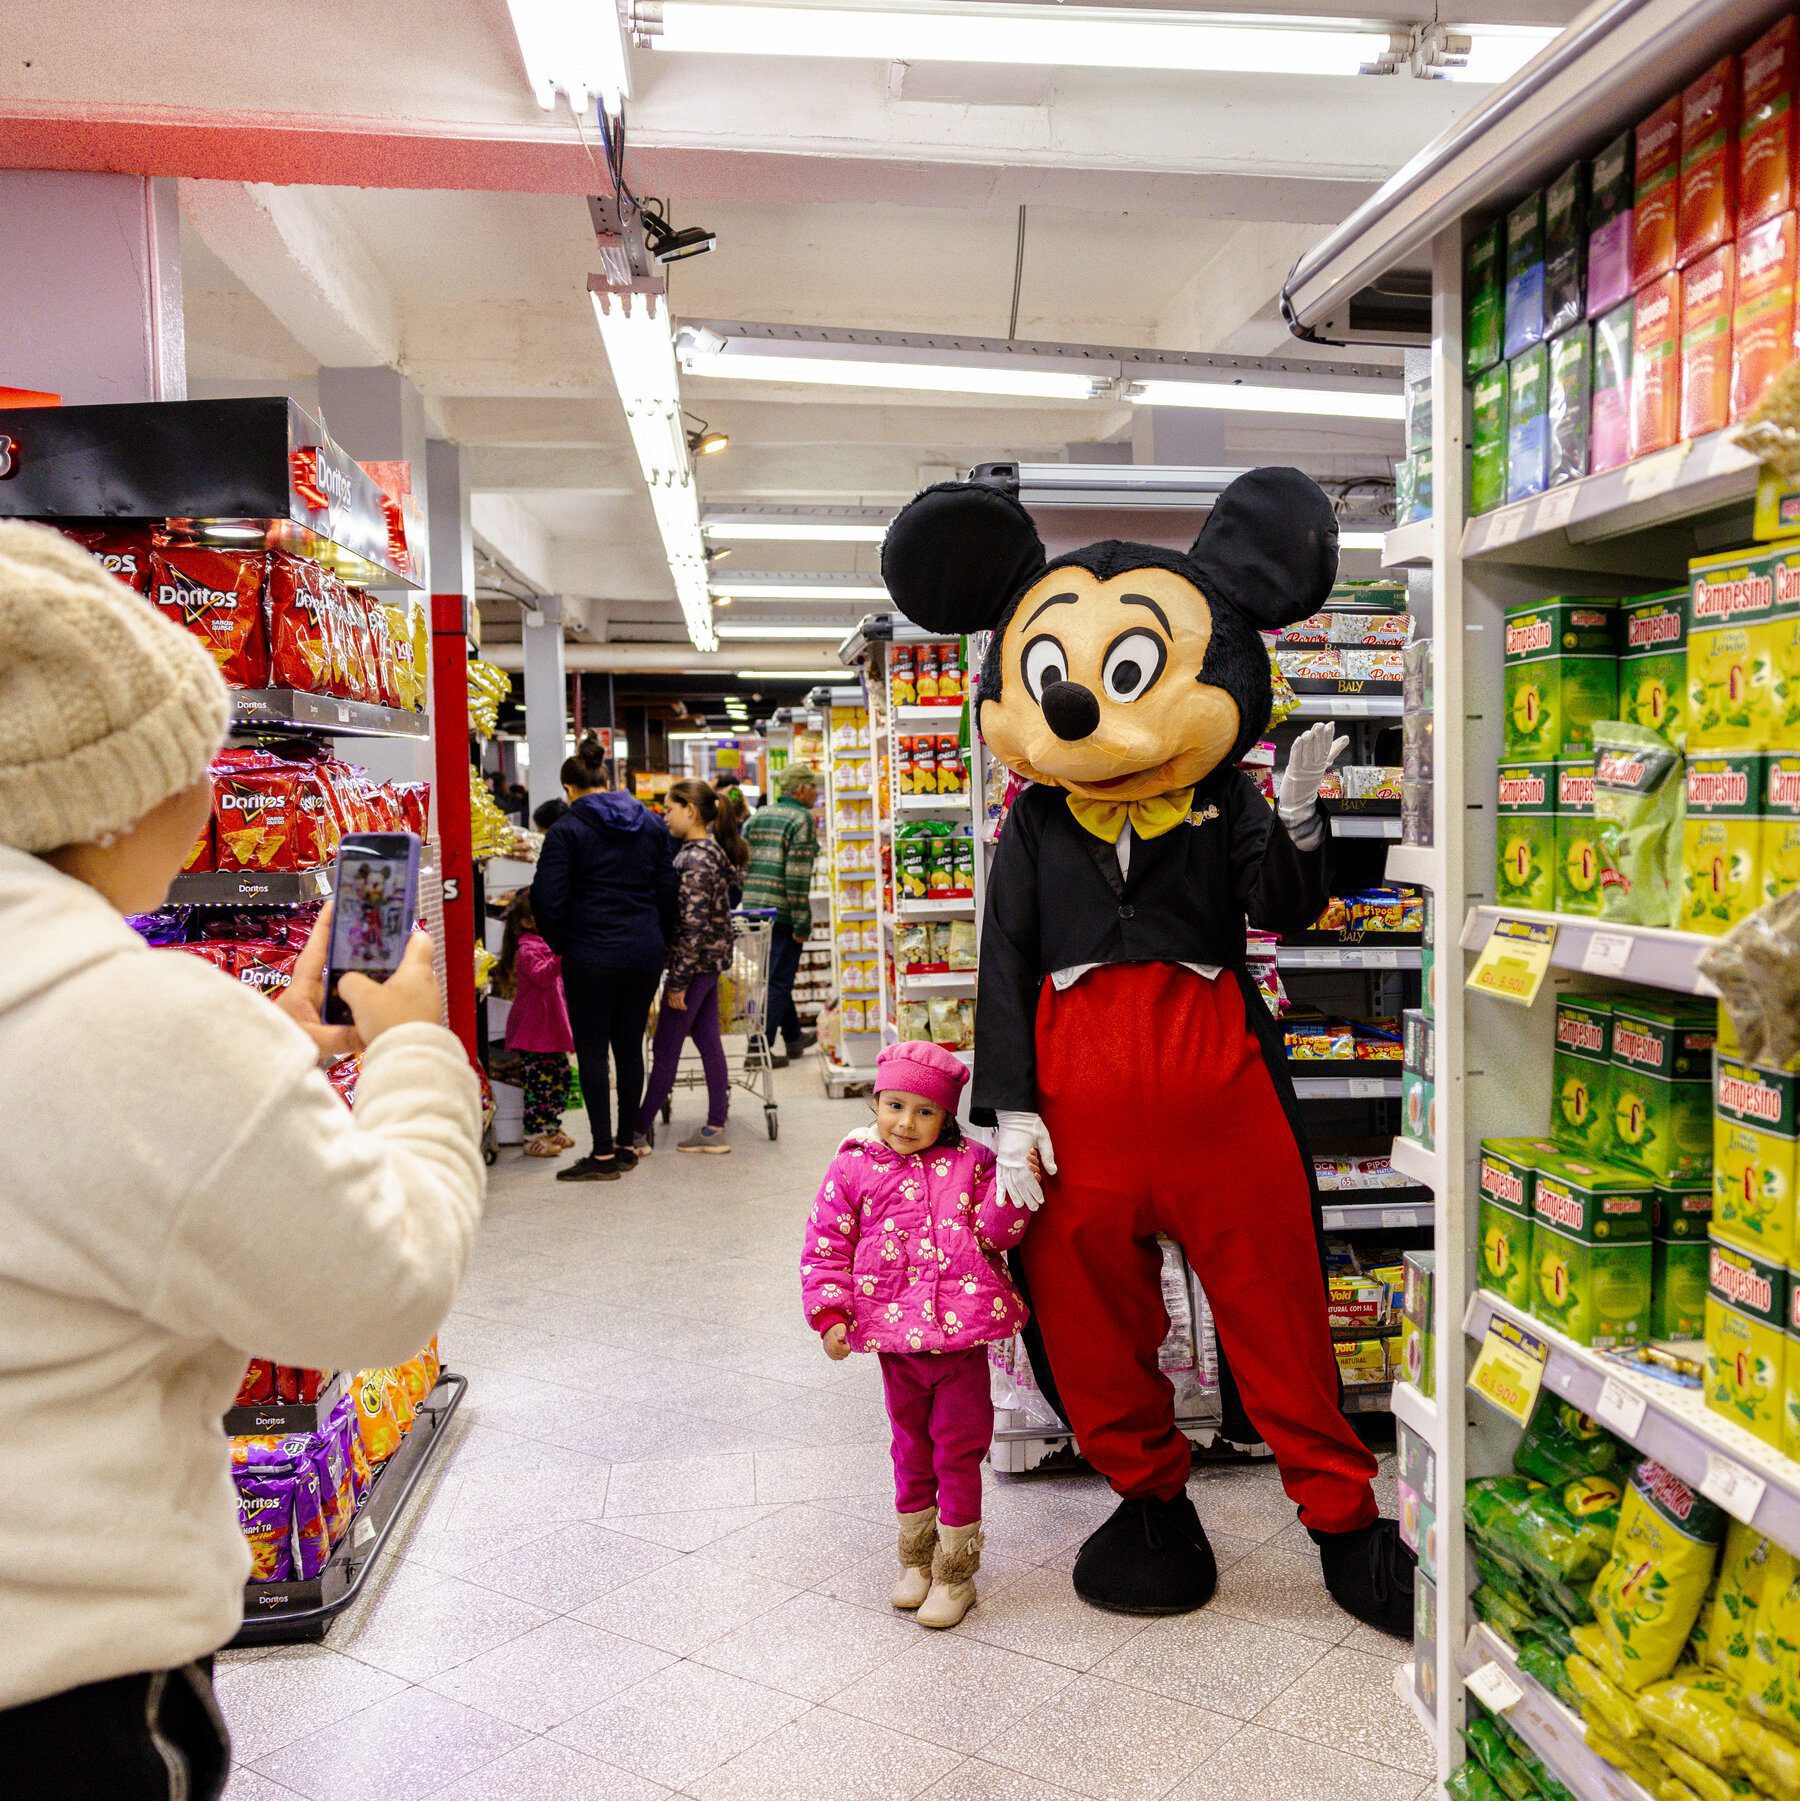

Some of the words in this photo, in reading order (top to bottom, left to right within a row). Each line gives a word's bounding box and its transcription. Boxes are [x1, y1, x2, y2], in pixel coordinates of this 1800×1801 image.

[318, 453, 352, 507] Doritos
[1775, 563, 1800, 606] Cam
[159, 585, 238, 608] Doritos
[1694, 572, 1773, 621] Campesino
[1506, 622, 1552, 657] Campesino
[1629, 611, 1680, 650] Campesino
[1369, 668, 1403, 680] Poro
[1338, 680, 1364, 693] BALY
[237, 701, 267, 709] Doritos
[1498, 773, 1545, 809] Campesino
[1559, 771, 1594, 809] Campes
[1687, 765, 1747, 812] Campesino
[222, 794, 286, 809] Doritos
[1341, 800, 1367, 811] BALY
[238, 884, 269, 892] Doritos
[1339, 930, 1365, 943] BALY
[241, 968, 292, 988] Dorito
[1558, 1012, 1603, 1051] Campesino
[1613, 1022, 1664, 1067] Campesino
[1717, 1067, 1782, 1123] Campesino
[1314, 1163, 1335, 1171] OCA
[1367, 1160, 1391, 1170] PIPO
[1481, 1157, 1523, 1206] Campesino
[1535, 1180, 1583, 1231] Campesino
[1710, 1247, 1772, 1313] Campesino
[1341, 1357, 1366, 1365] NATURAL
[256, 1417, 285, 1425] Doritos
[235, 1497, 280, 1508] Doritos
[259, 1594, 288, 1604] Doritos
